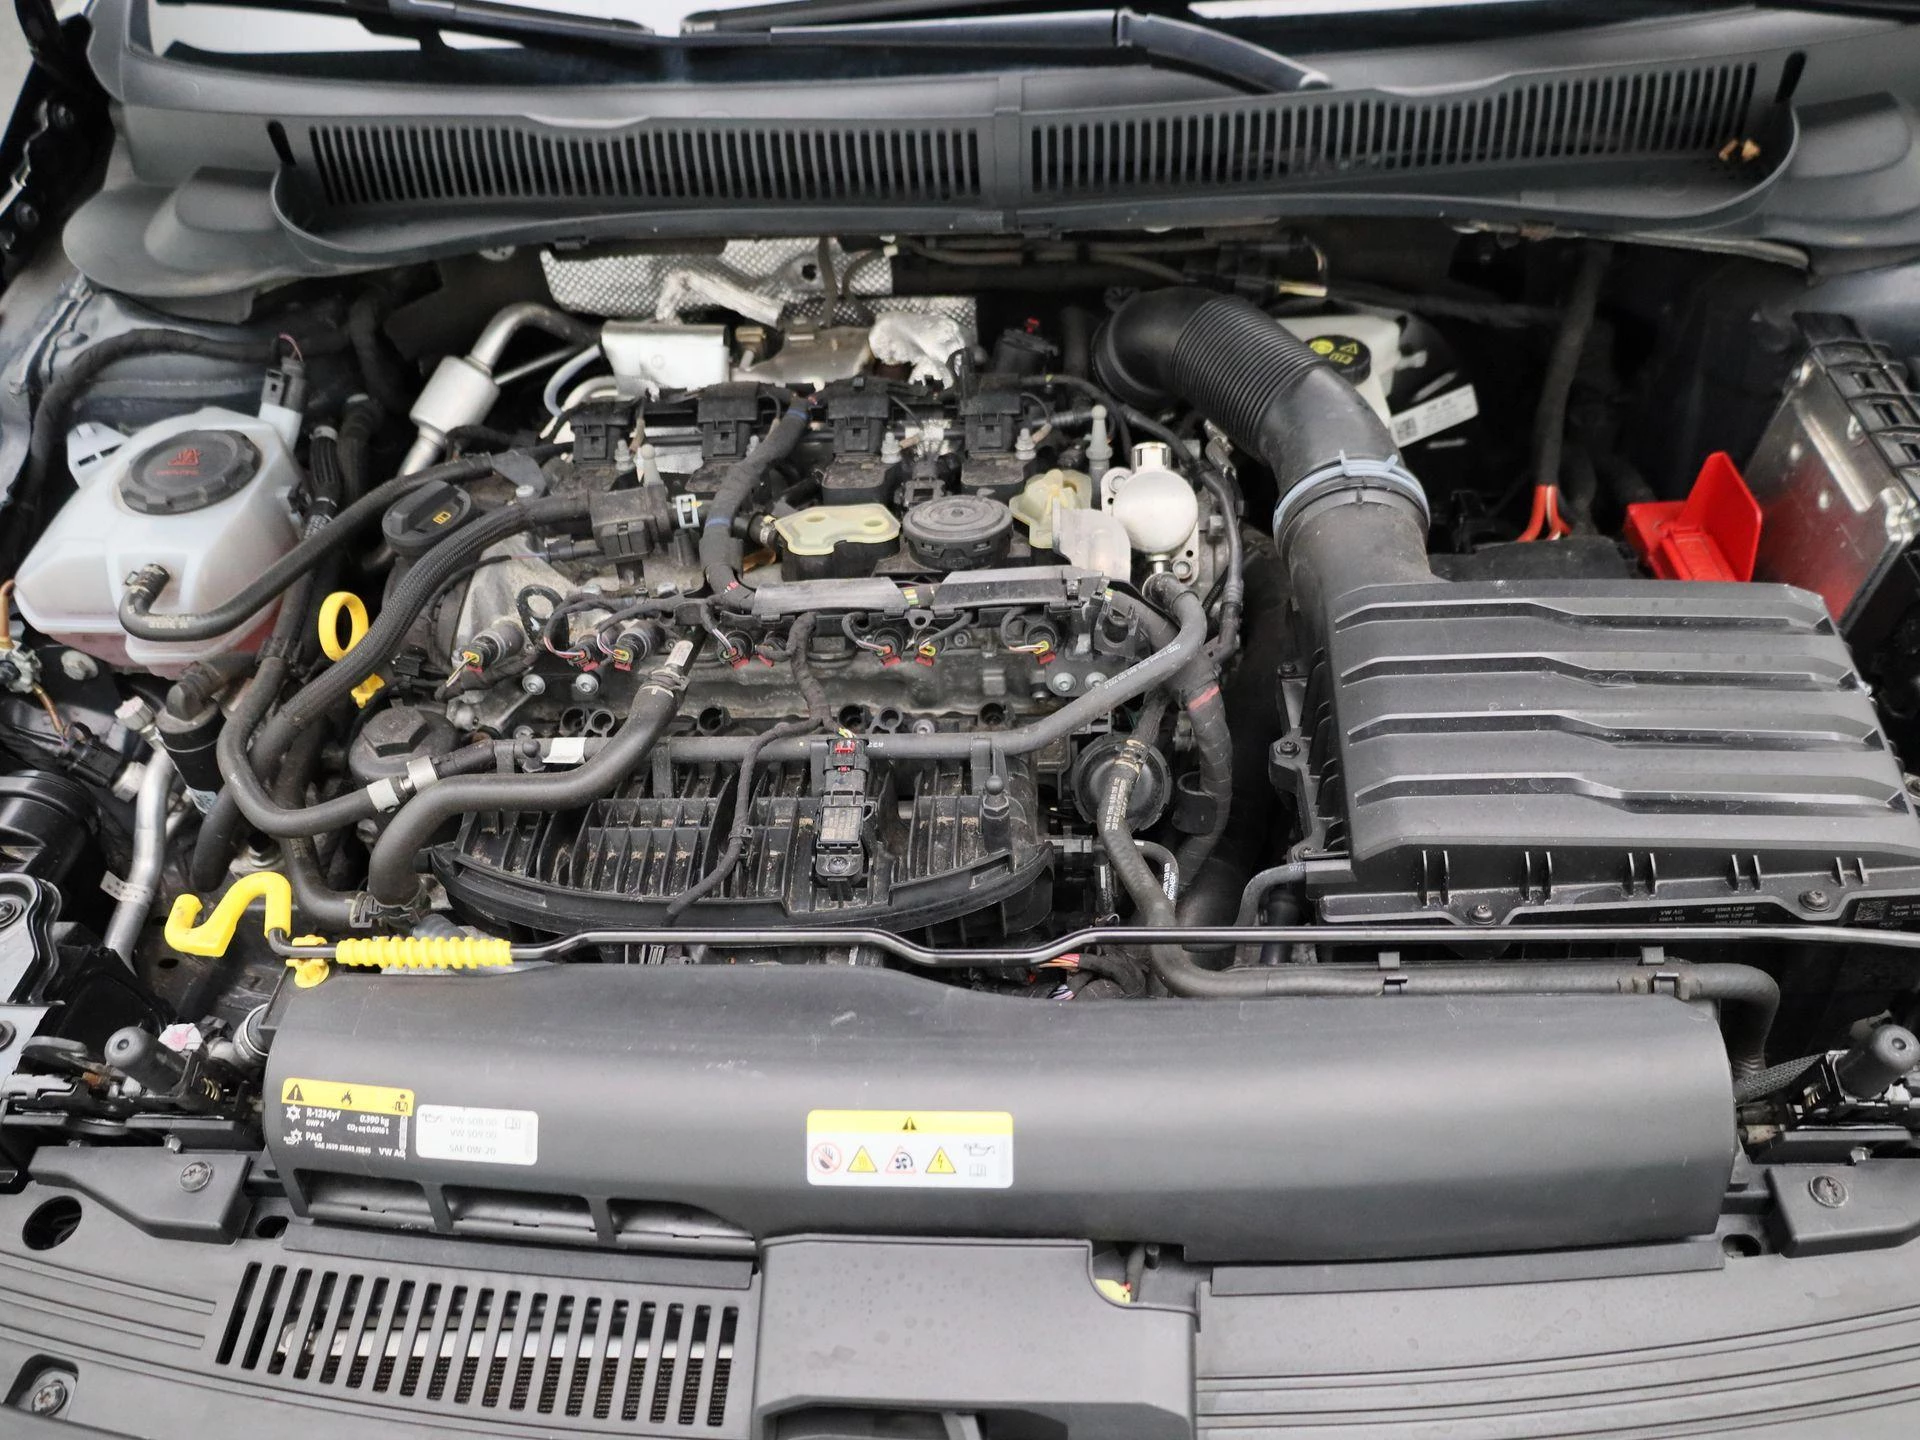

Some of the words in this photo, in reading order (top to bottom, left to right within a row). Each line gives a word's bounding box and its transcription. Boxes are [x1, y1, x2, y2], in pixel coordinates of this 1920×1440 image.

[306, 1108, 341, 1122] R-1234yf
[450, 1116, 465, 1124] VW
[380, 1115, 389, 1126] kg
[305, 1132, 322, 1141] PAG
[378, 1147, 392, 1156] VW
[394, 1149, 406, 1158] AG
[448, 1144, 465, 1153] SAE
